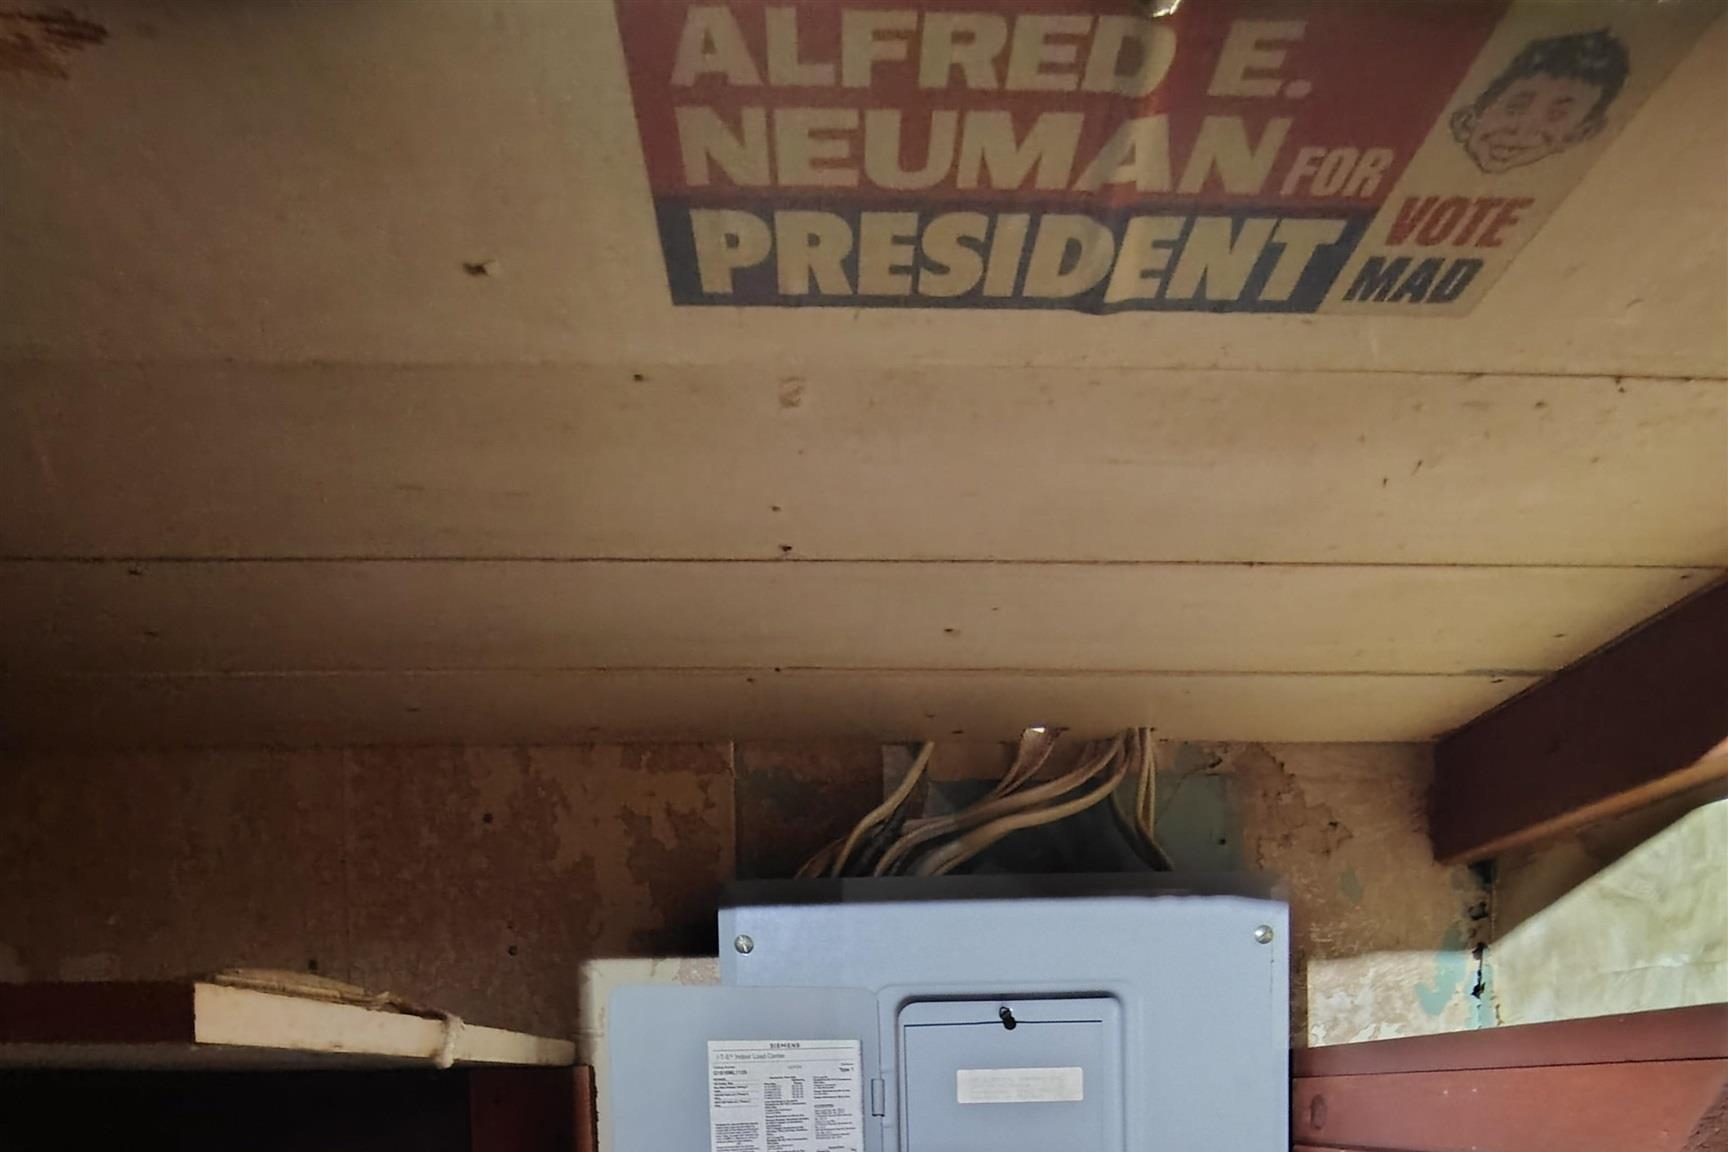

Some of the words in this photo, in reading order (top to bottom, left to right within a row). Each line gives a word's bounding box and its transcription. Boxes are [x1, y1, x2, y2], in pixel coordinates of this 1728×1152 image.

[670, 5, 1177, 97] ALFRED
[1207, 20, 1312, 98] E.
[674, 105, 1294, 195] NEUMAN
[1280, 146, 1393, 197] FOR
[690, 209, 1347, 302] PRESIDENT
[1385, 196, 1535, 248] VOTE
[1342, 256, 1485, 304] MAD
